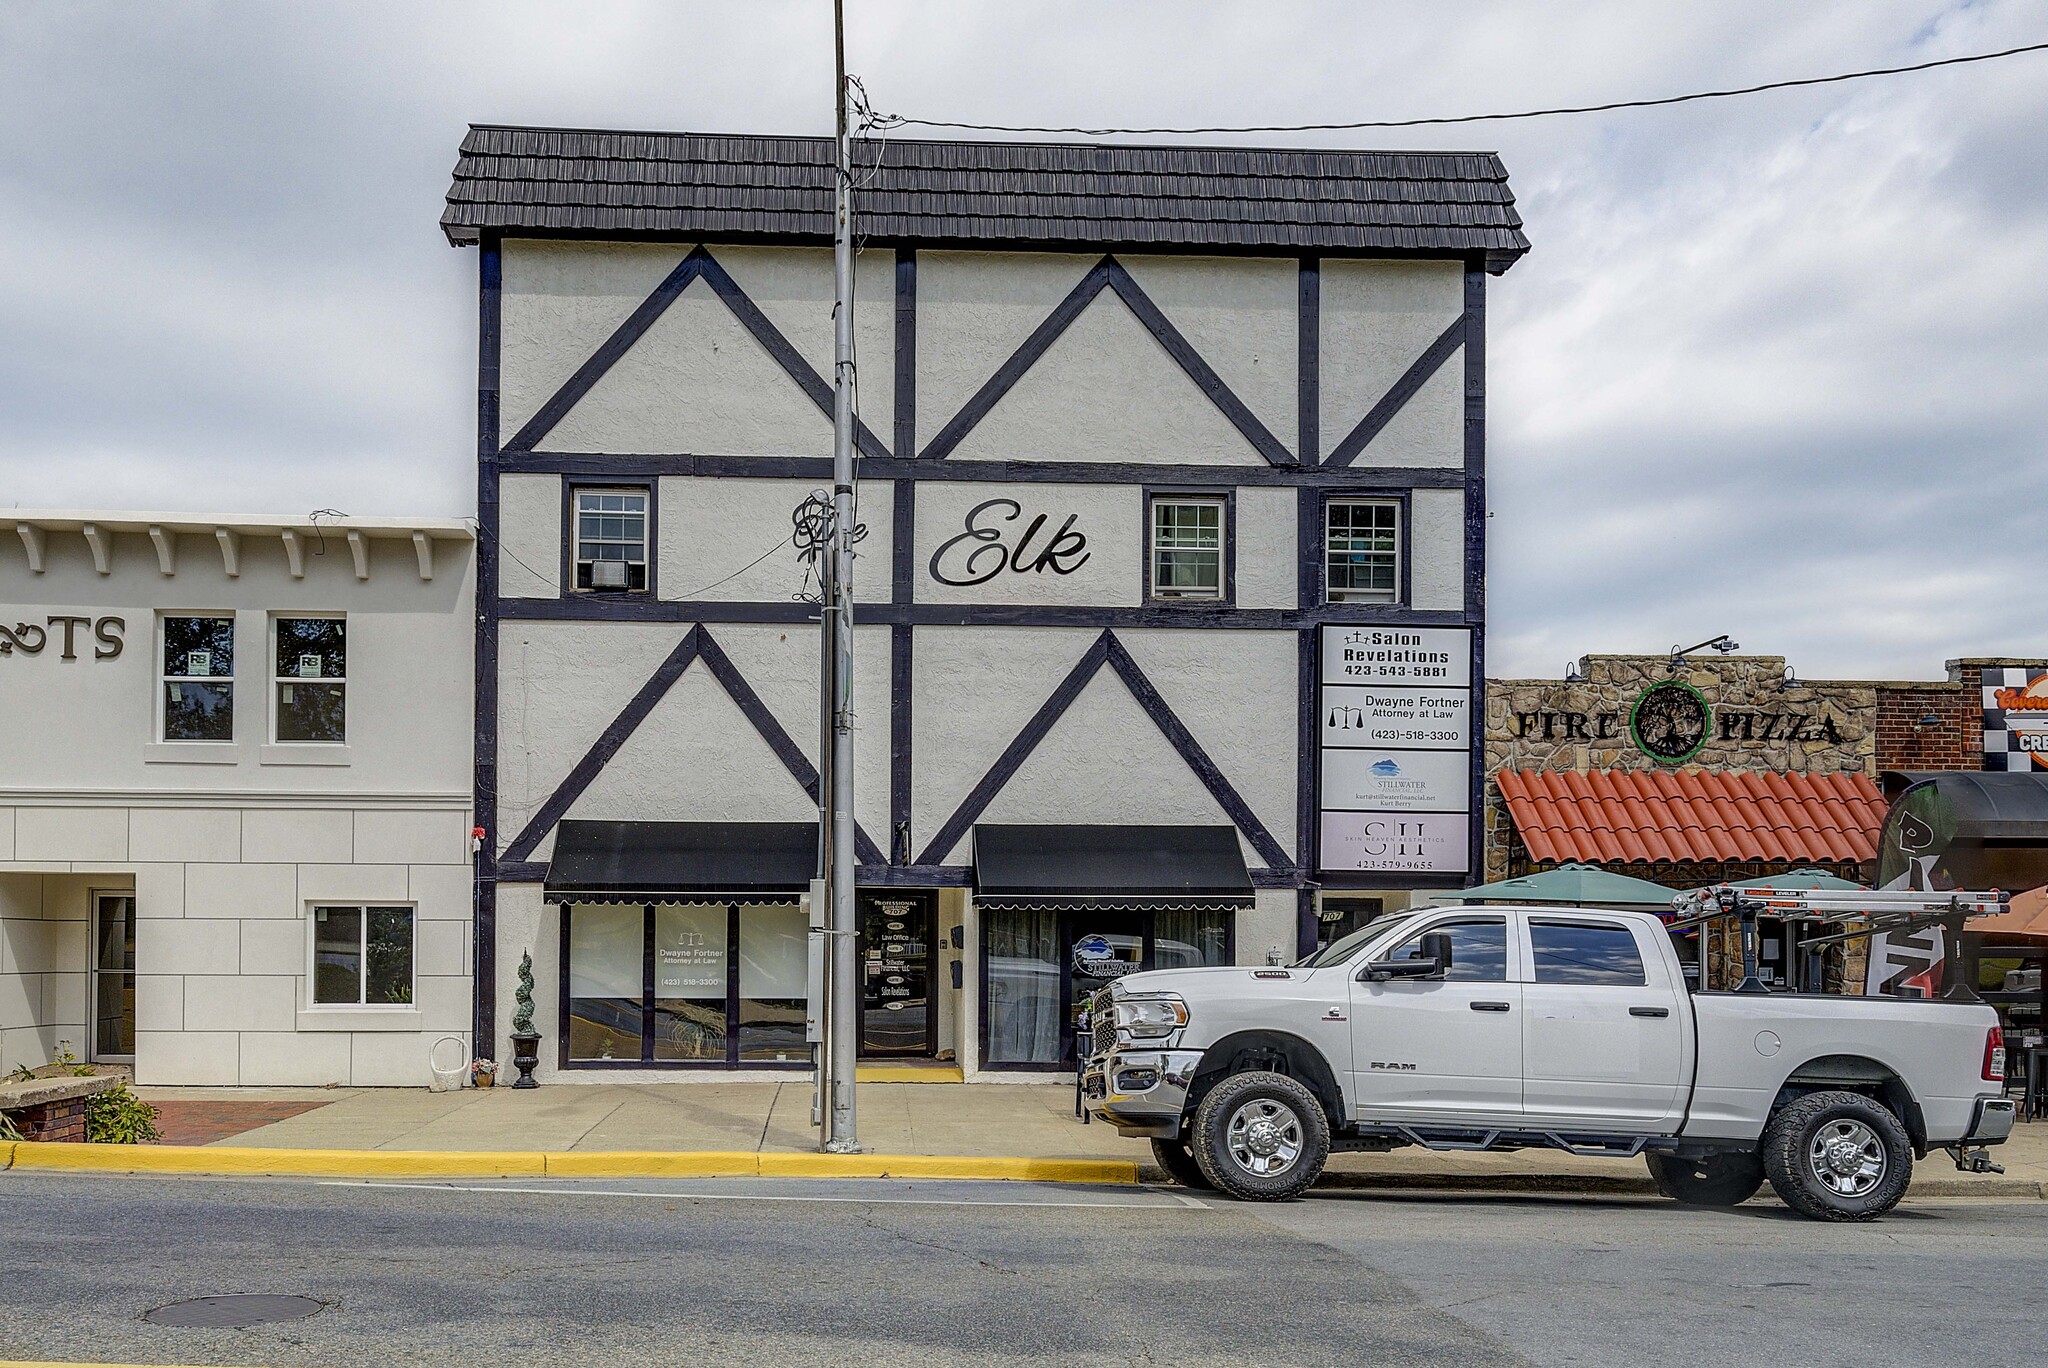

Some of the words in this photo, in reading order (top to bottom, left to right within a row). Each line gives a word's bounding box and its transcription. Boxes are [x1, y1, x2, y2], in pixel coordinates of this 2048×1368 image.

[929, 498, 1091, 586] Elk
[1372, 632, 1421, 646] Salon
[190, 654, 207, 664] RB
[1344, 648, 1449, 663] Revelations
[302, 657, 319, 666] RB
[1344, 665, 1447, 677] 423-543-5881
[1365, 695, 1414, 709] Dwayne
[1420, 697, 1465, 708] Fortner
[1372, 709, 1415, 719] Attorney
[1419, 710, 1429, 718] at
[1434, 709, 1453, 718] Law
[1515, 711, 1620, 741] FIRE
[1718, 712, 1844, 744] PIZZA
[1371, 729, 1459, 741] (423)-518-3300
[1378, 781, 1426, 789] STILLWATER
[1355, 793, 1436, 801] kurt@stillwaterfinancial.net
[1357, 860, 1433, 870] 423-579-9655
[660, 949, 691, 958] Dwayne
[694, 949, 723, 957] Fortner
[663, 957, 691, 965] Attorney
[1087, 963, 1141, 971] STILLWATER
[1371, 1061, 1416, 1070] RAM
